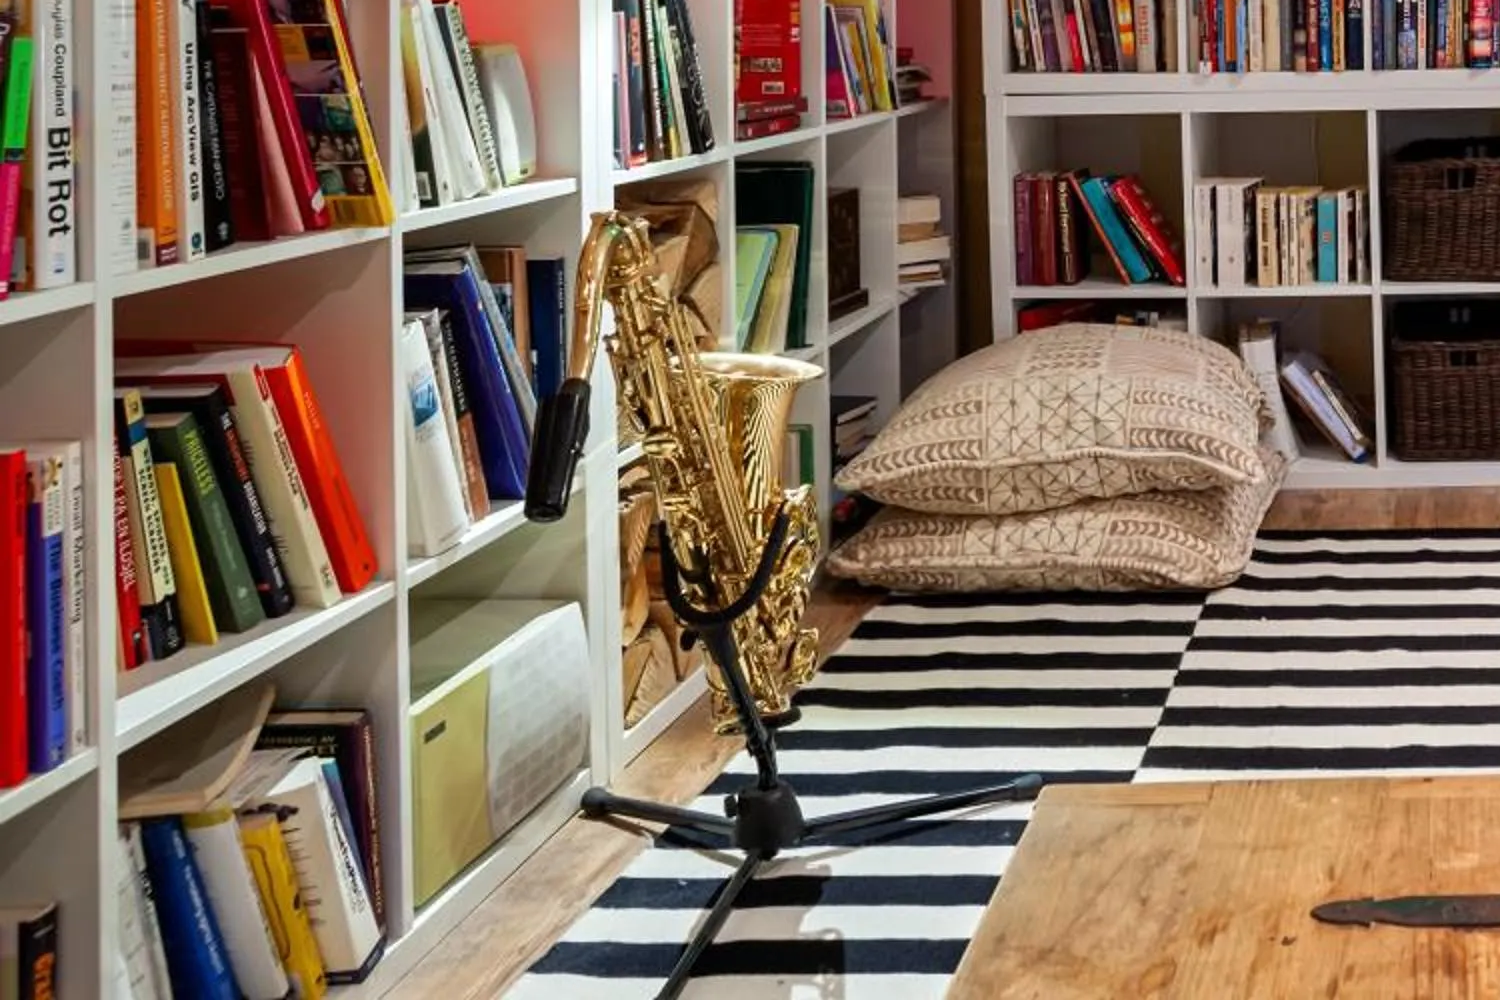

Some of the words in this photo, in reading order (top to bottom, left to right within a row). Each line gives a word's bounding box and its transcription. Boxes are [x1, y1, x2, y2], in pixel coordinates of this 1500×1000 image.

[53, 43, 67, 117] Coupland
[184, 43, 195, 91] Using
[47, 126, 71, 171] Bit
[186, 95, 199, 166] ArcView
[47, 179, 72, 238] Rot
[189, 170, 200, 202] GIS
[183, 430, 216, 492] PRICELESS
[49, 542, 62, 572] The
[67, 535, 84, 625] Marketing
[50, 581, 64, 653] Business
[51, 659, 64, 711] Coach
